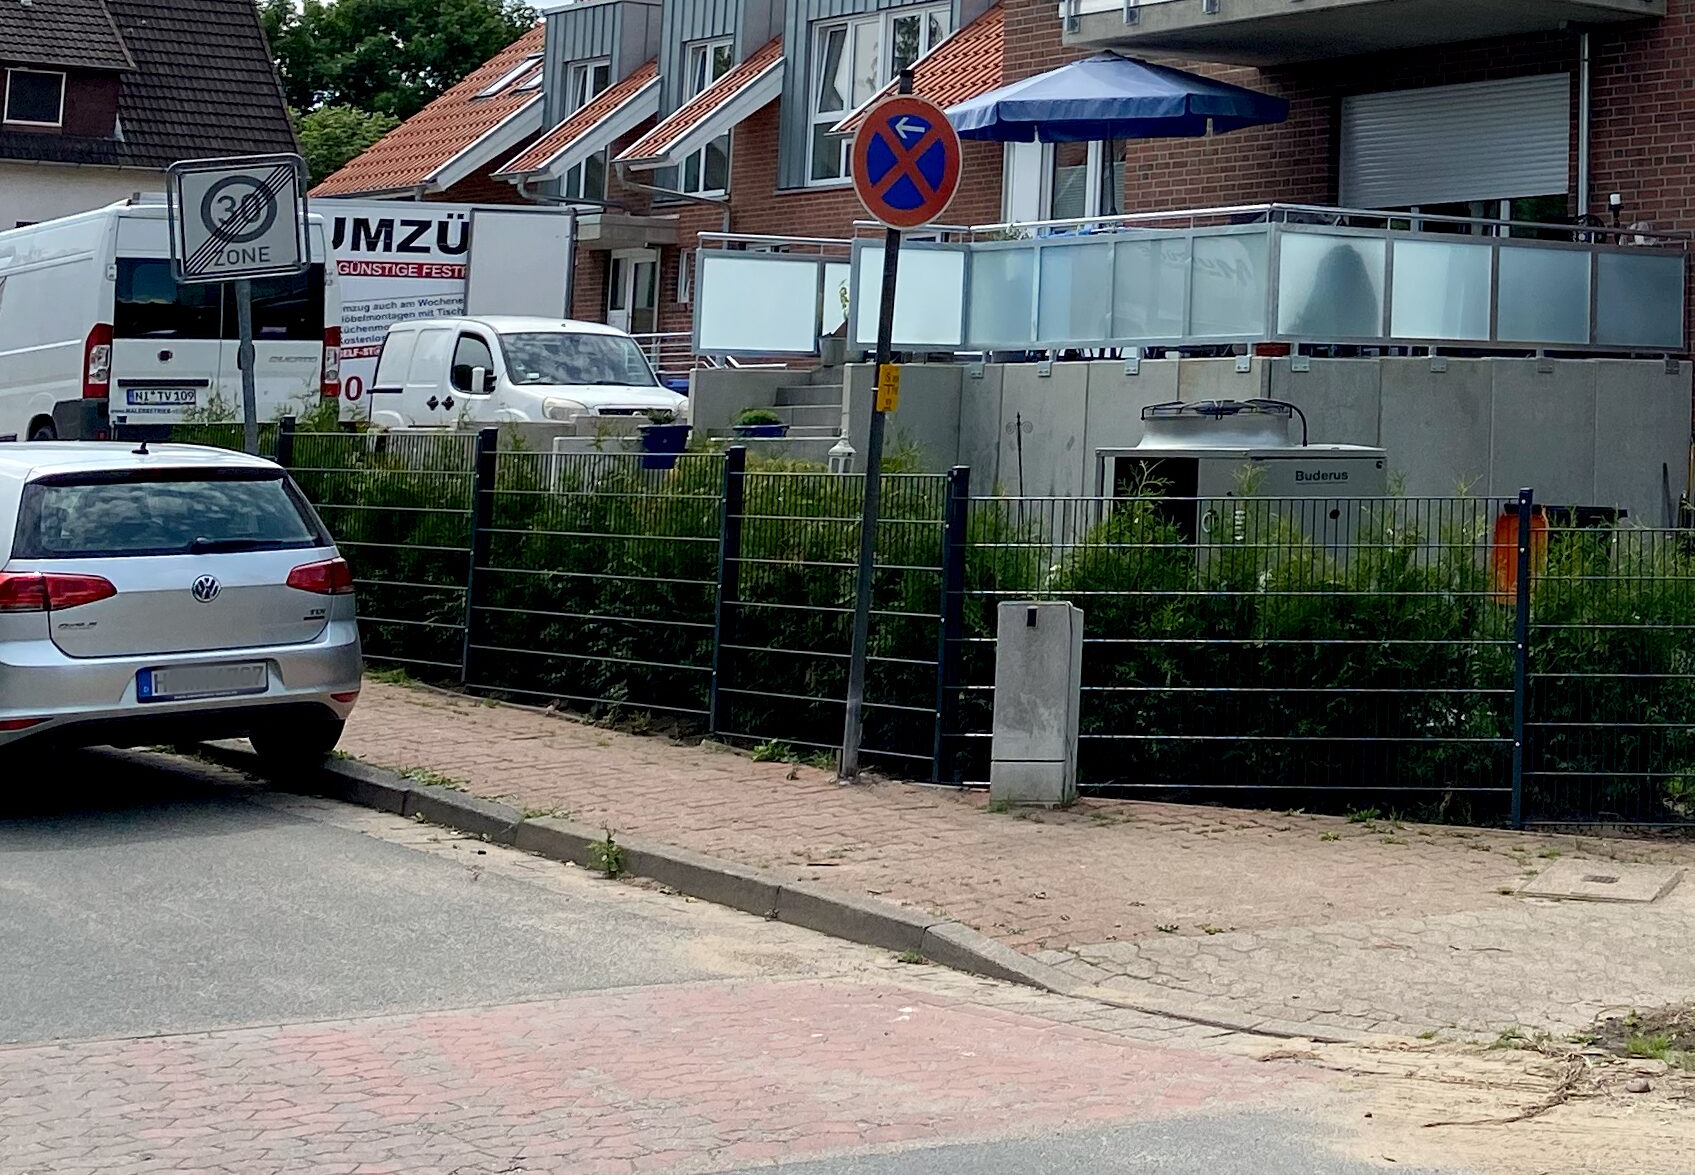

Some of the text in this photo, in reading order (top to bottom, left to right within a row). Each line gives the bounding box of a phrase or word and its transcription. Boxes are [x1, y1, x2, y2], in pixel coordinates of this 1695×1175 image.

[214, 246, 271, 266] ZONE
[339, 261, 418, 277] GÜNSTIGE
[174, 390, 194, 401] 109
[1296, 470, 1348, 481] Buderus
